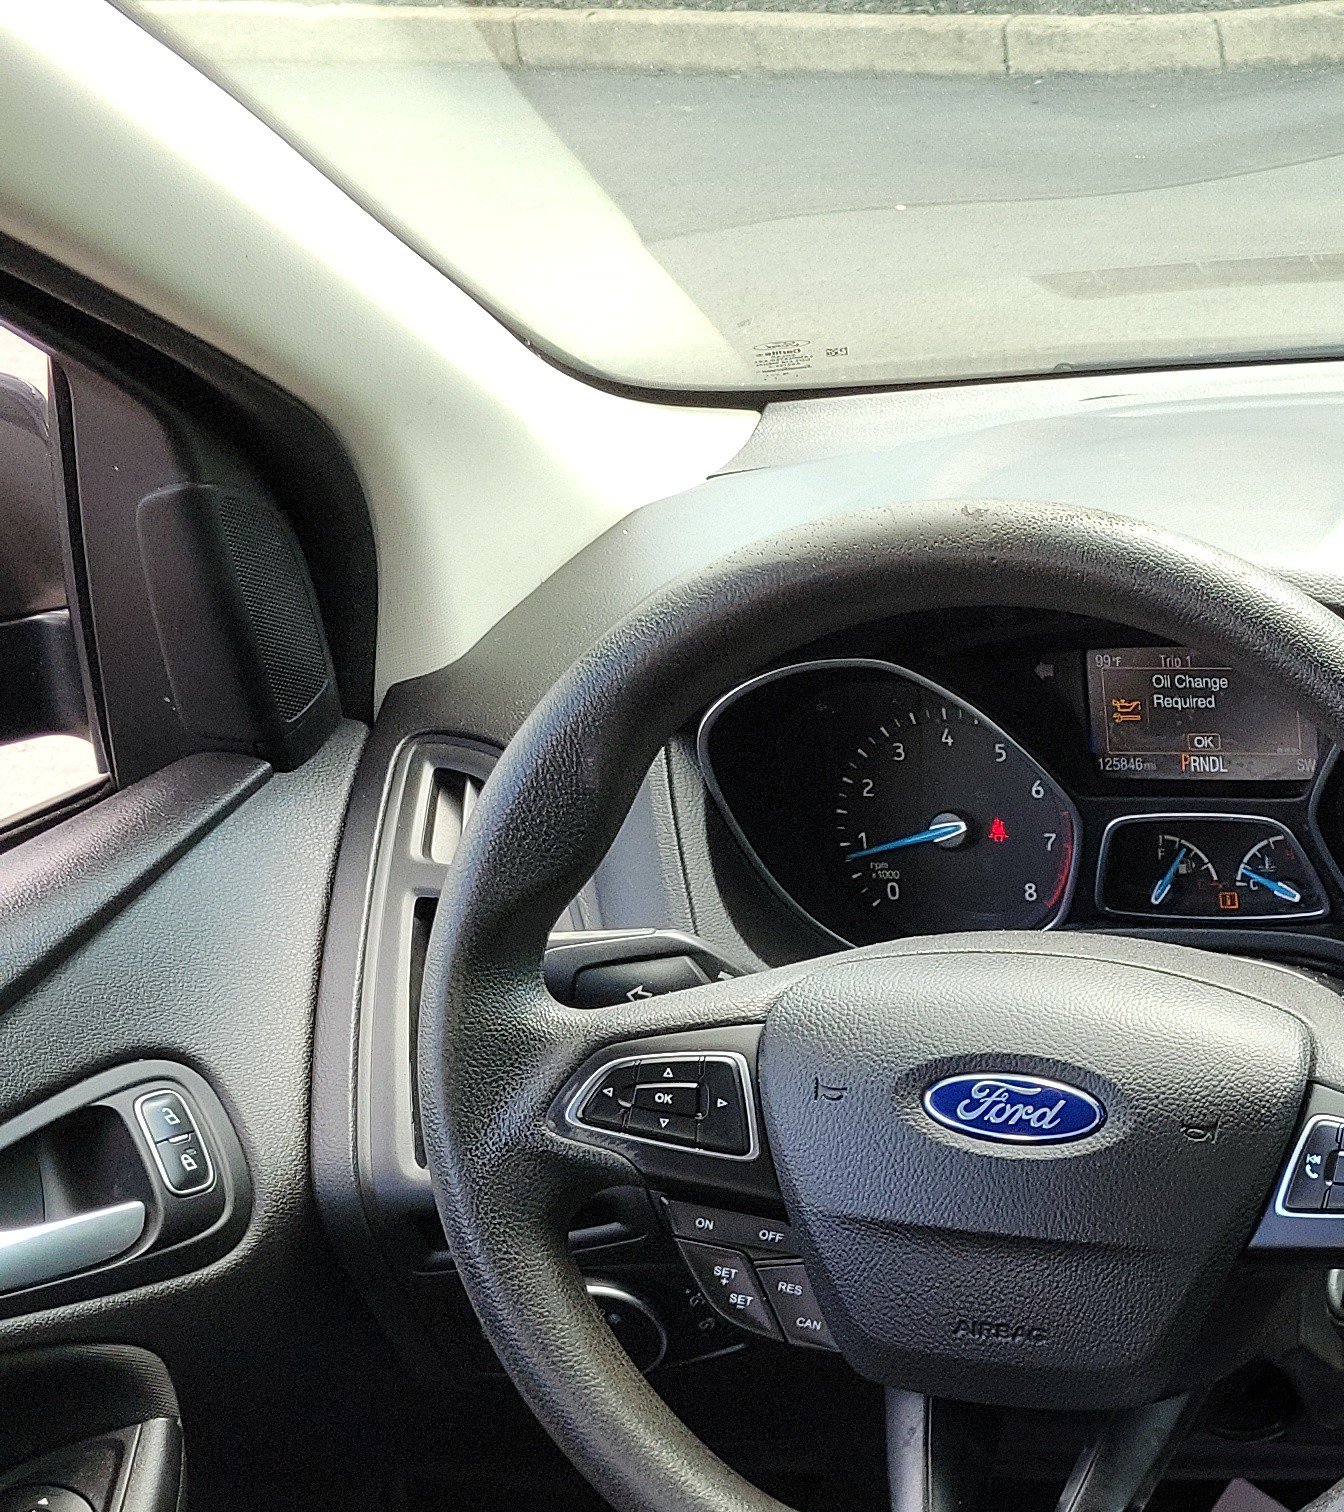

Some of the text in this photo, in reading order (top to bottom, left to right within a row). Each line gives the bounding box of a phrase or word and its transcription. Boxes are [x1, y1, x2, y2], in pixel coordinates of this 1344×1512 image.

[1152, 675, 1228, 690] Oil Change
[1153, 695, 1215, 709] Required
[941, 728, 953, 746] 4
[1194, 737, 1214, 748] OK
[893, 743, 905, 761] 3
[995, 744, 1006, 762] 5
[1181, 754, 1228, 773] PRNDL
[862, 779, 874, 797] 2
[1031, 780, 1044, 798] 6
[858, 832, 867, 849] 1
[1044, 833, 1056, 851] 7
[887, 883, 899, 900] 0
[1024, 883, 1037, 901] 8
[655, 1093, 672, 1105] OK
[957, 1080, 1066, 1129] Ford
[695, 1217, 714, 1230] ON
[758, 1230, 784, 1243] OFF
[713, 1266, 738, 1279] SET
[777, 1281, 803, 1295] RES
[729, 1293, 753, 1306] SET
[796, 1316, 822, 1330] CAN
